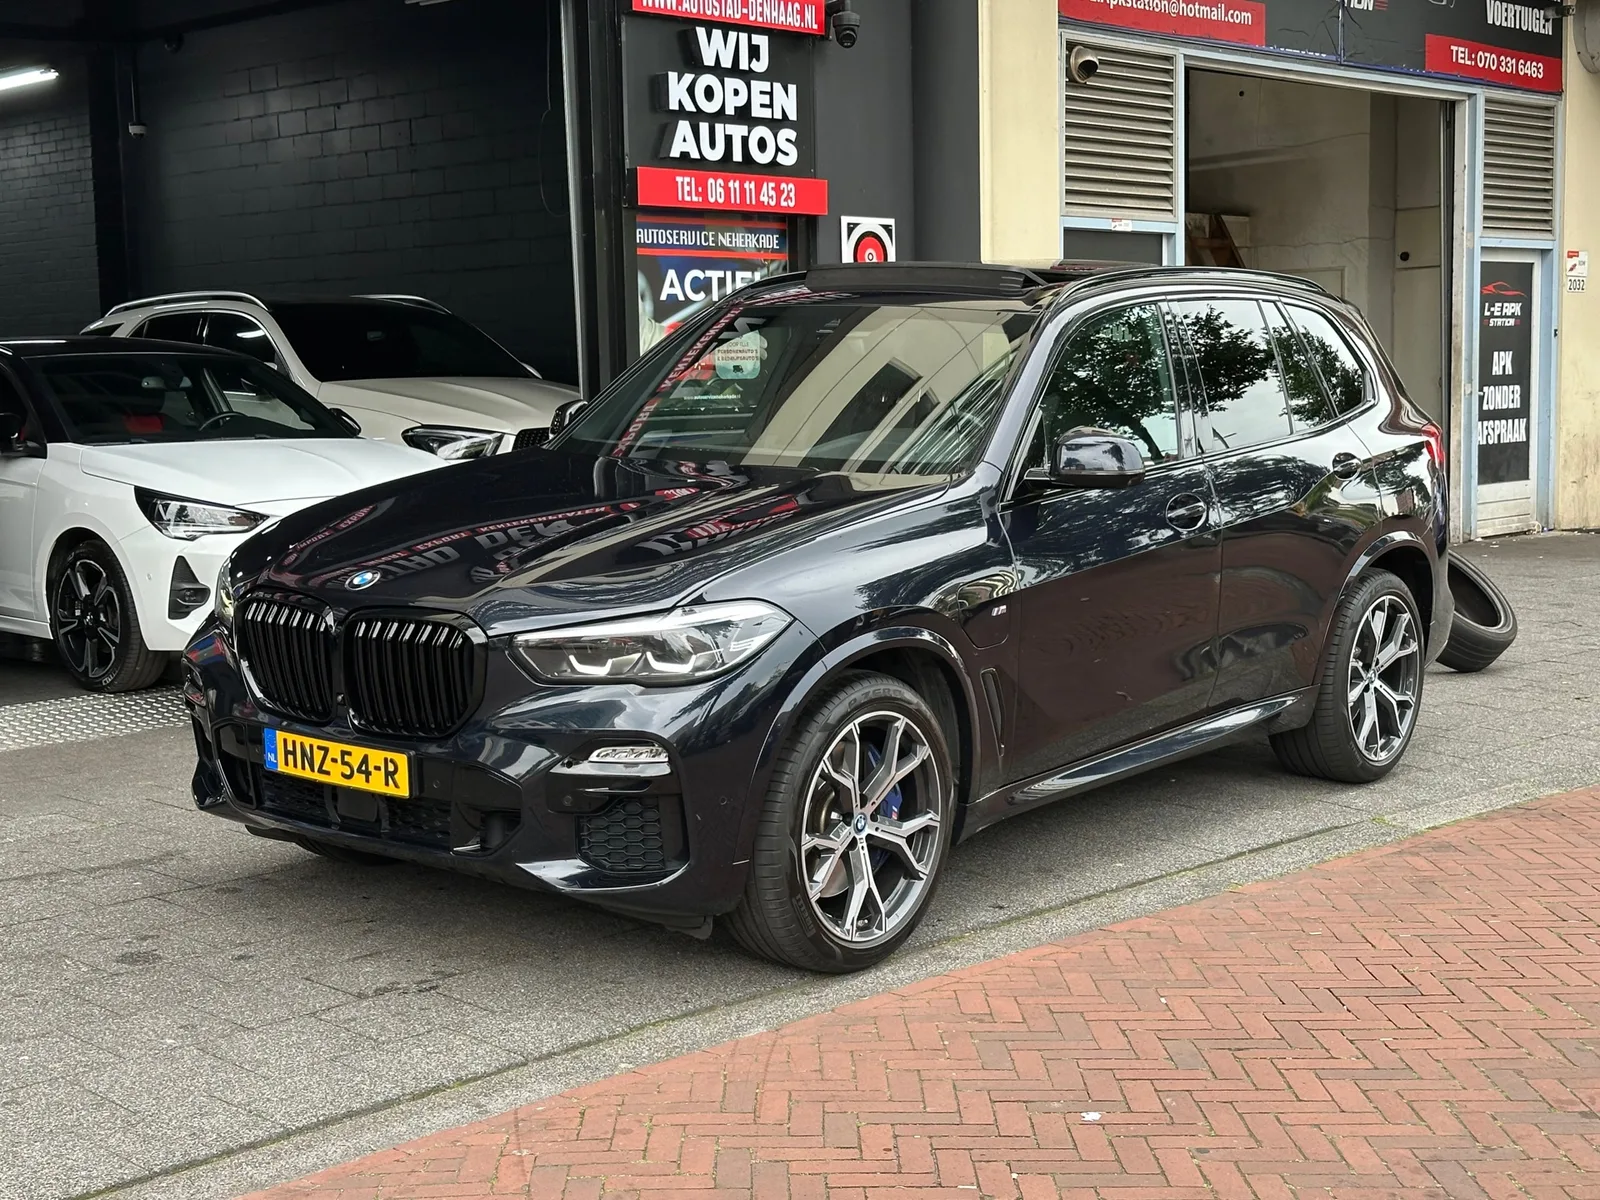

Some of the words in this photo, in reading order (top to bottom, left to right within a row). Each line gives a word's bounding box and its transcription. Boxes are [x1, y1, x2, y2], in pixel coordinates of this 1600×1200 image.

[695, 26, 769, 73] WIJ
[1450, 45, 1475, 66] TEL:
[1476, 51, 1498, 71] 070
[1499, 55, 1516, 74] 331
[1518, 59, 1544, 79] 6463
[667, 71, 797, 121] KOPEN
[669, 119, 798, 166] AUTOS
[675, 176, 703, 202] TEL:
[707, 177, 725, 204] 06
[728, 179, 740, 205] 11
[743, 180, 756, 205] 11
[760, 181, 776, 207] 45
[780, 182, 796, 208] 23
[636, 228, 716, 247] AUTOSERVICE
[718, 232, 780, 250] NEHERKADE
[1568, 278, 1585, 291] 2032
[1484, 302, 1503, 316] L-E
[1502, 302, 1522, 316] APK
[1489, 318, 1516, 327] STATION
[1492, 351, 1513, 376] APK
[1482, 385, 1521, 411] ZONDER
[1478, 418, 1527, 445] AFSPRAAK
[267, 752, 277, 763] NL
[282, 737, 400, 789] HNZ-54-R
